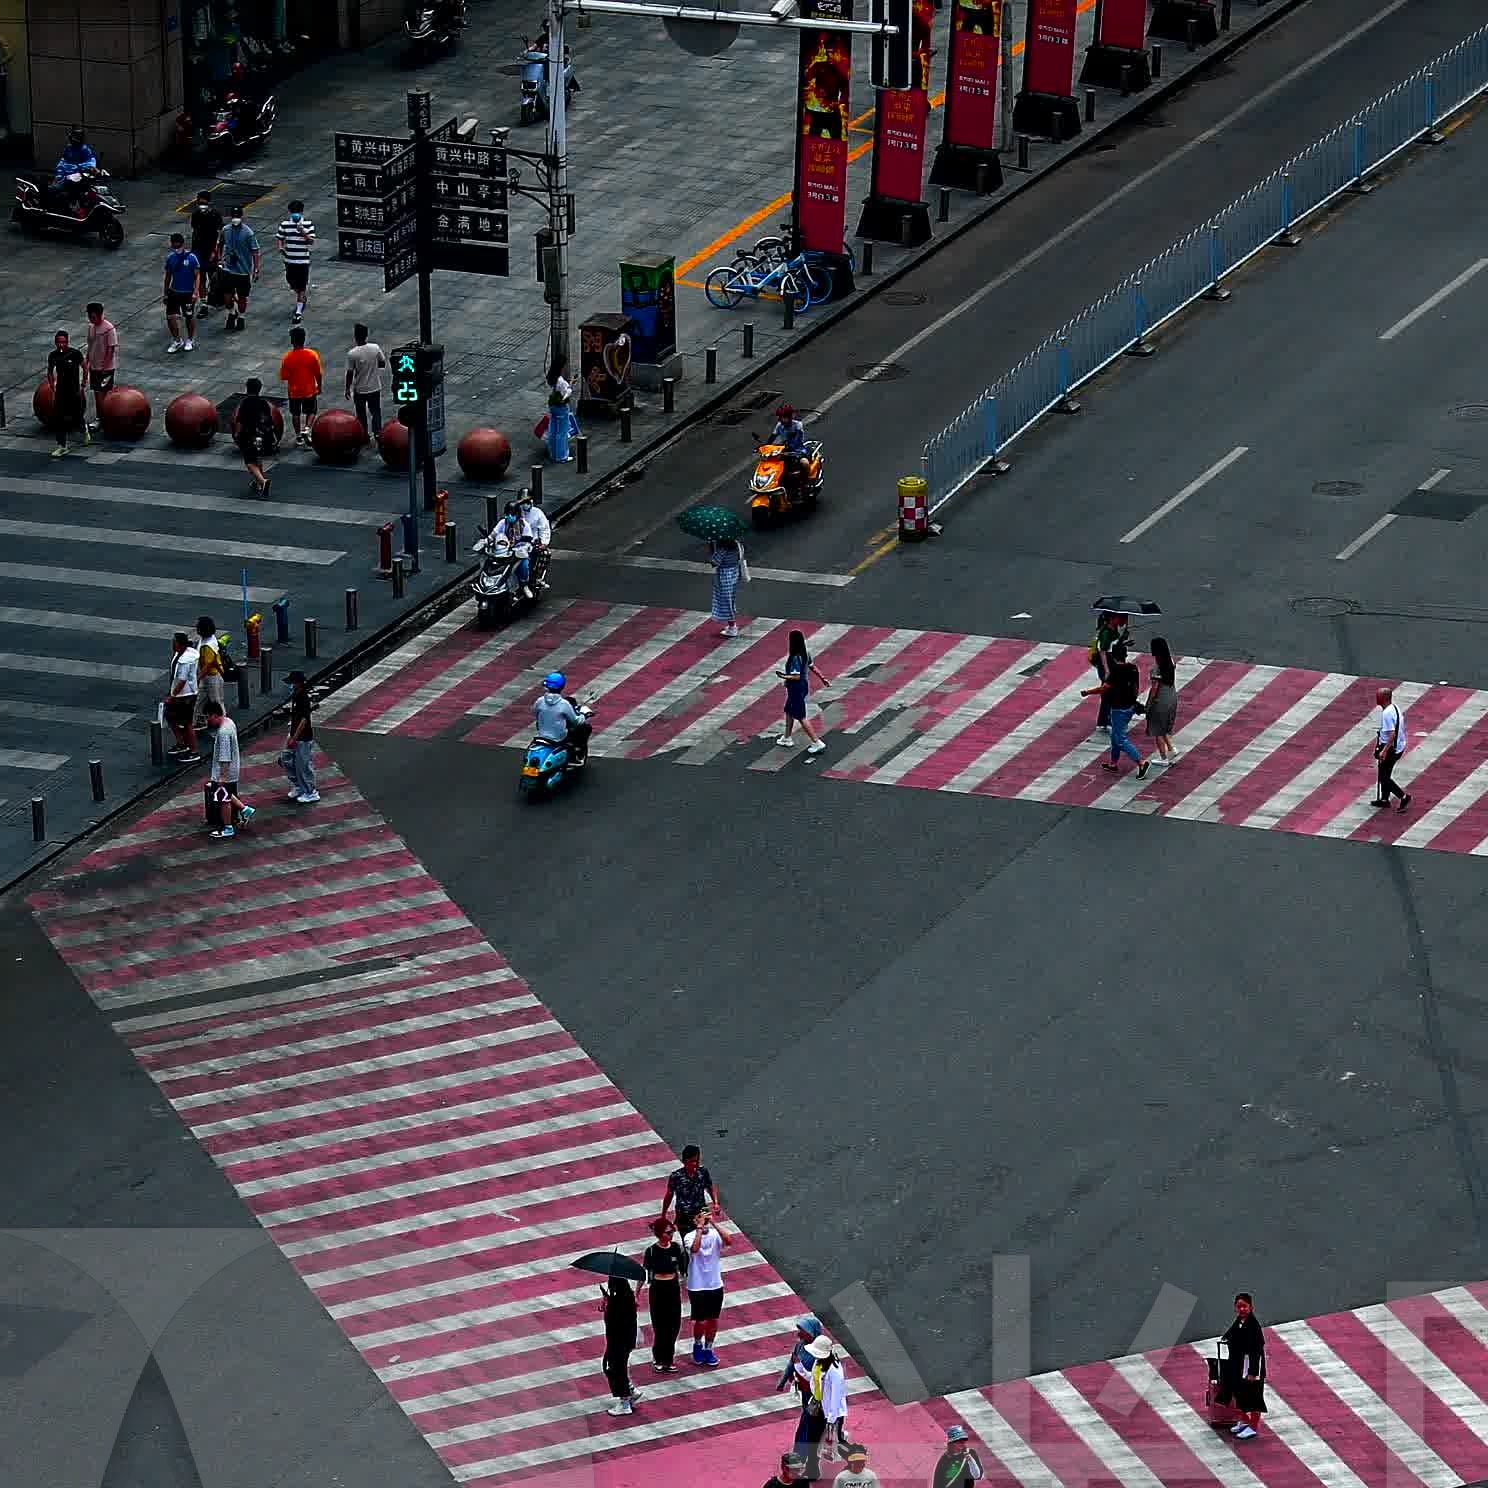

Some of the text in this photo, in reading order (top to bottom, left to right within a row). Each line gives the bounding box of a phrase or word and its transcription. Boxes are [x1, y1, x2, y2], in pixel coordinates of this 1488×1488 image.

[351, 139, 404, 158] 黄兴中路
[435, 147, 491, 165] 黄兴中路
[436, 178, 491, 199] 中山亭
[437, 214, 492, 232] 金满地
